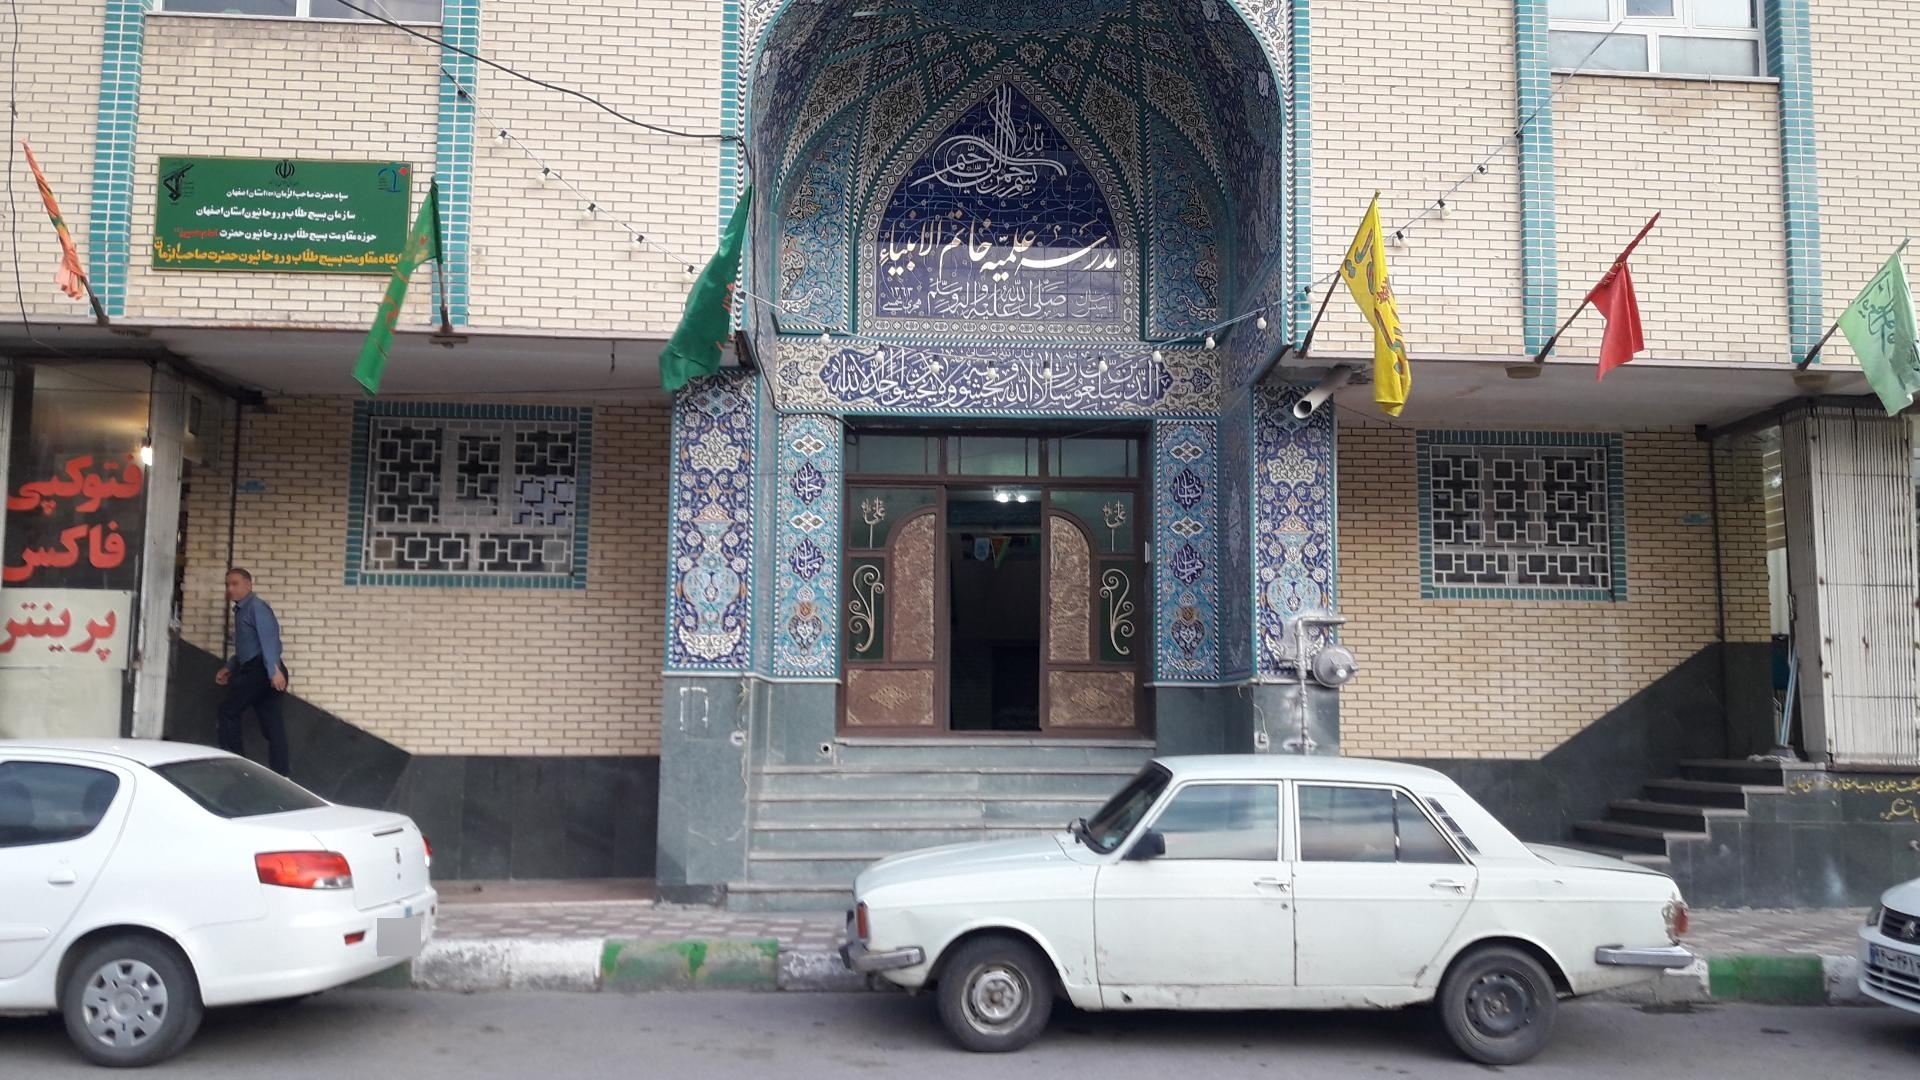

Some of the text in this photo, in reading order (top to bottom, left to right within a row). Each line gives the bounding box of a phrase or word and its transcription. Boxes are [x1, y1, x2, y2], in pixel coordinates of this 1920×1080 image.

[226, 187, 248, 197] اصفهان
[295, 190, 315, 200] صاحب
[315, 191, 335, 201] حضرت
[335, 191, 349, 202] سپاه
[196, 204, 224, 216] اصفهان
[223, 206, 245, 217] استان
[244, 207, 281, 219] روحانیون
[286, 206, 307, 218] طلاب
[307, 210, 327, 222] بسیج
[327, 209, 356, 221] سازمان
[219, 229, 244, 239] حضرت
[244, 229, 281, 241] روحانیون
[287, 227, 308, 240] طلاب
[308, 231, 328, 243] بسیج
[328, 230, 357, 242] مقاومت
[357, 231, 377, 243] حوزه
[939, 208, 993, 282] خاتم
[176, 247, 208, 264] صاحب
[207, 249, 239, 263] حضرت
[238, 248, 285, 265] روحانیون
[292, 248, 318, 264] طلاب
[318, 252, 344, 267] بسیج
[343, 250, 379, 267] مقاومت
[379, 252, 403, 270] ایگاه
[7, 454, 143, 515] فتوکپی
[2, 520, 126, 582] فاکس
